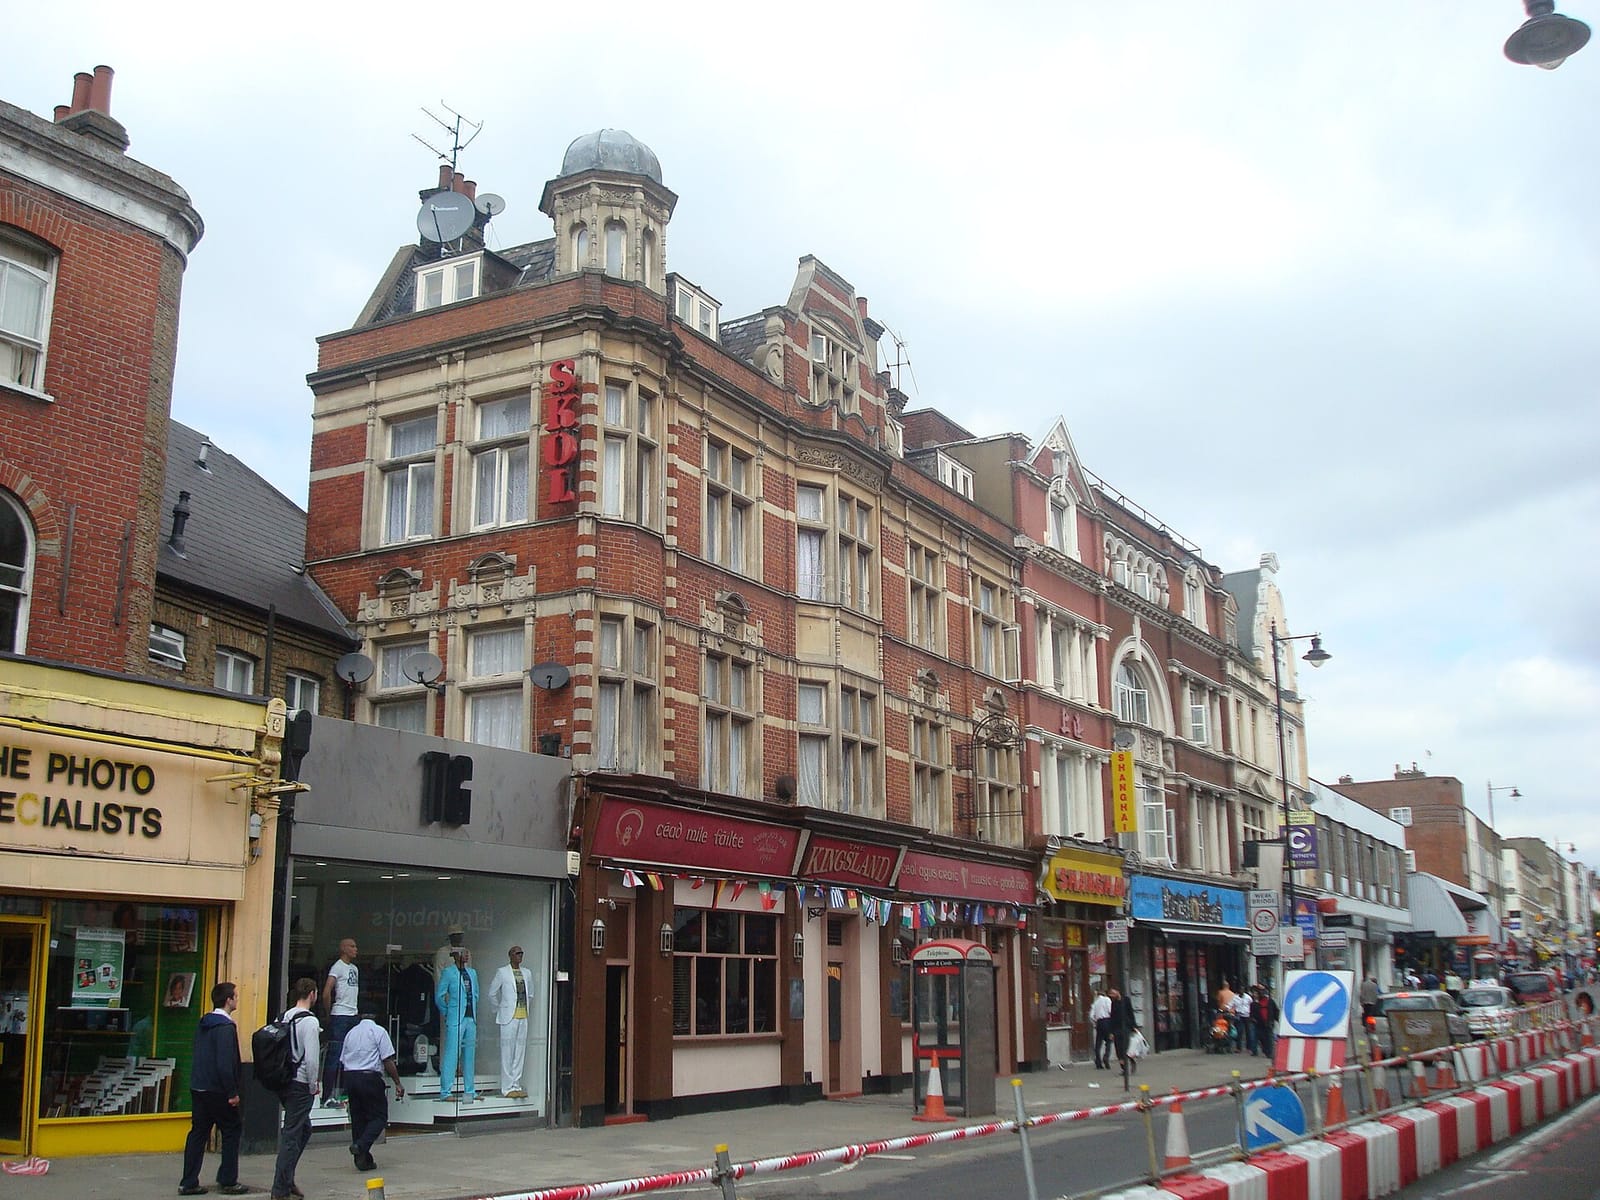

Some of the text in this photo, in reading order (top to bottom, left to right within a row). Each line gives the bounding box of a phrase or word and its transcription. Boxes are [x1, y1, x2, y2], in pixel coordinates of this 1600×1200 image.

[543, 358, 581, 504] SKOL
[47, 753, 155, 795] PHOTO
[1117, 753, 1129, 832] SHANGHAI
[0, 790, 163, 838] ECIALISTS
[803, 846, 891, 882] KINGSLAND
[848, 843, 866, 851] THE
